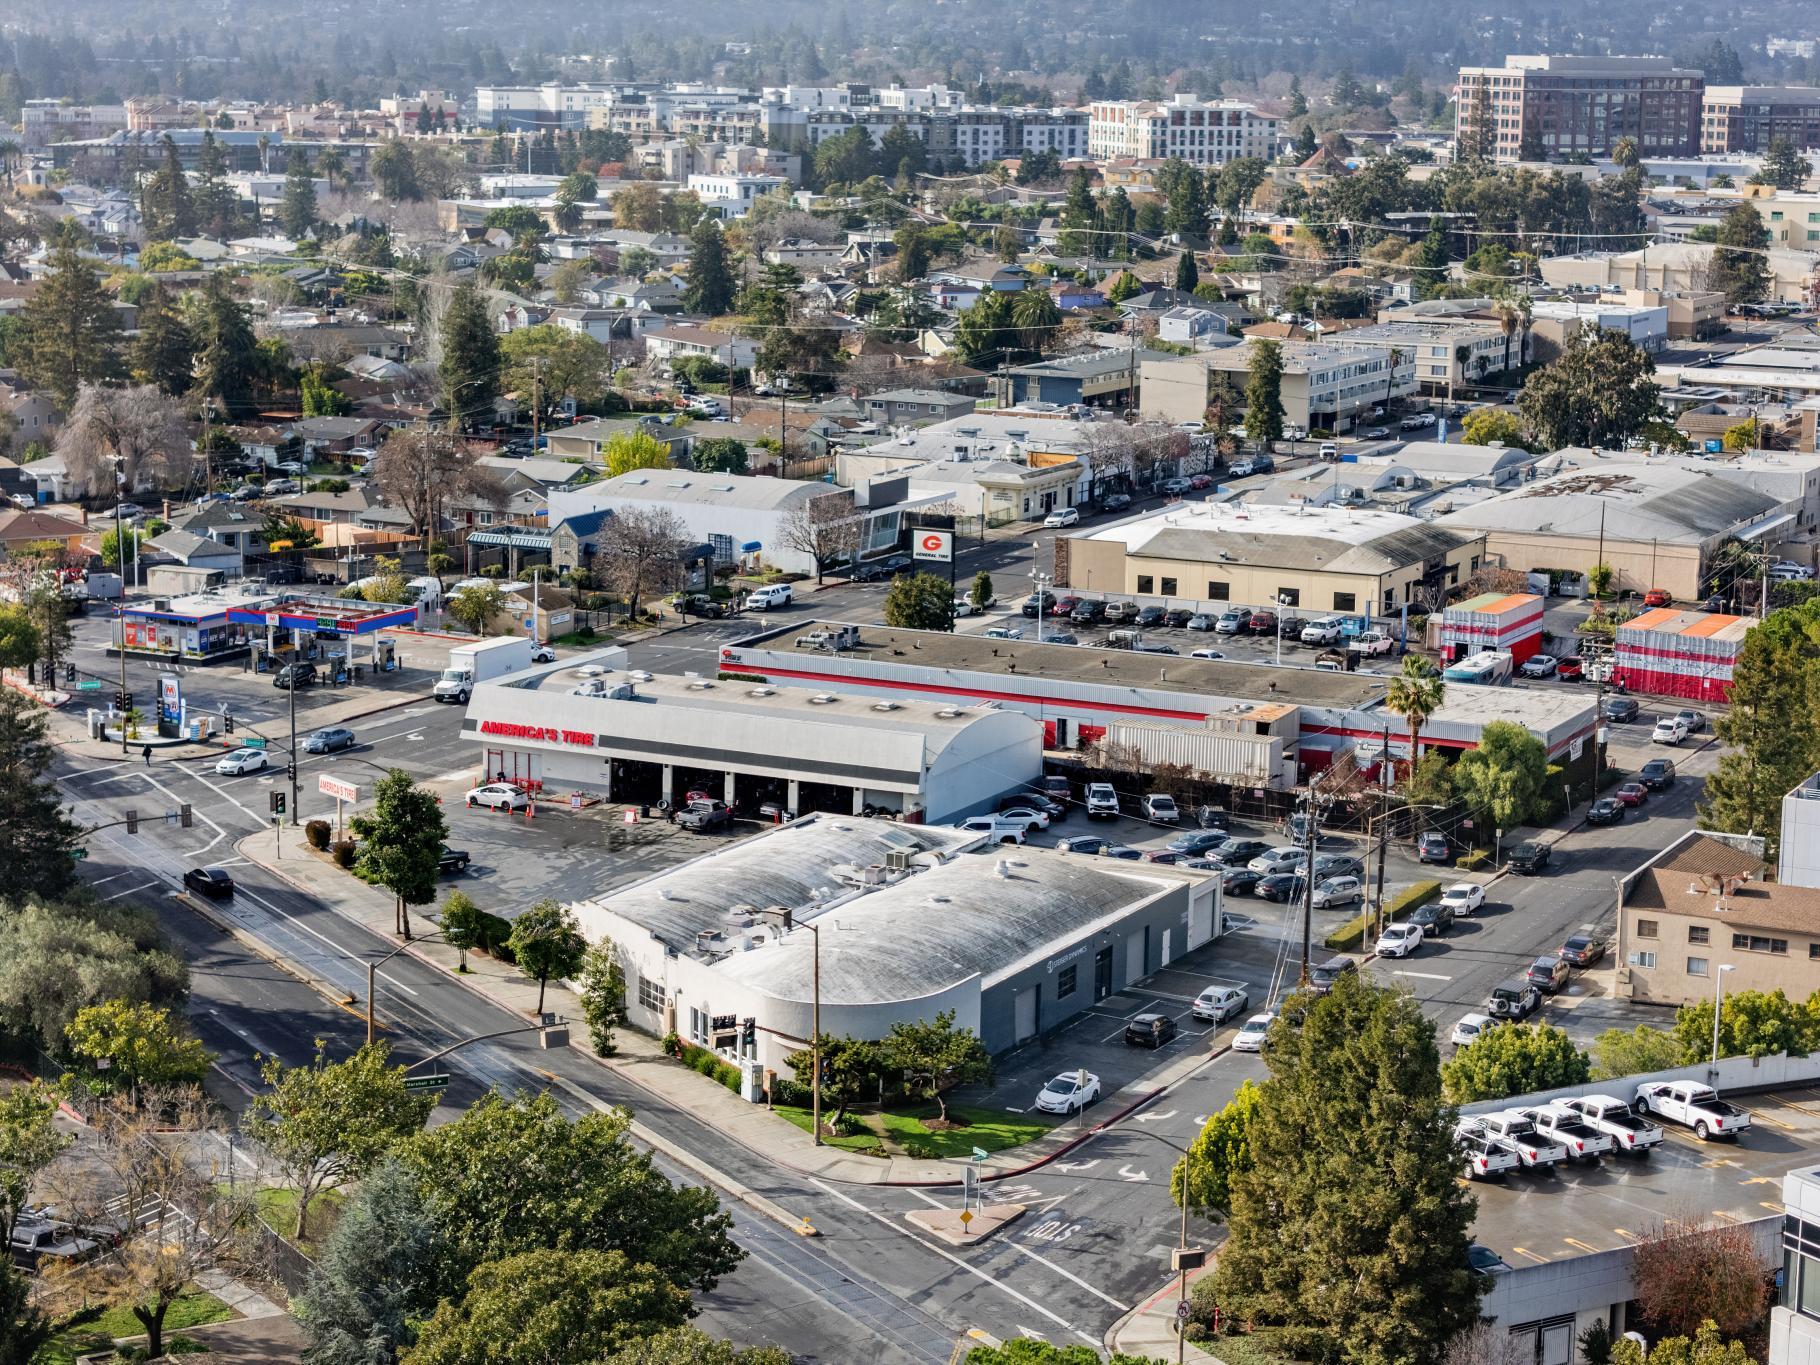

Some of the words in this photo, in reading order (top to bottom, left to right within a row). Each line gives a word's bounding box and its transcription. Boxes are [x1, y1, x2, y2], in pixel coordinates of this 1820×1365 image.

[922, 535, 942, 551] G
[480, 721, 557, 742] AMERICA'S
[562, 730, 595, 746] TIRE
[320, 778, 343, 796] AMERICA'S
[344, 787, 354, 800] TIRE
[1023, 1220, 1081, 1242] STOP
